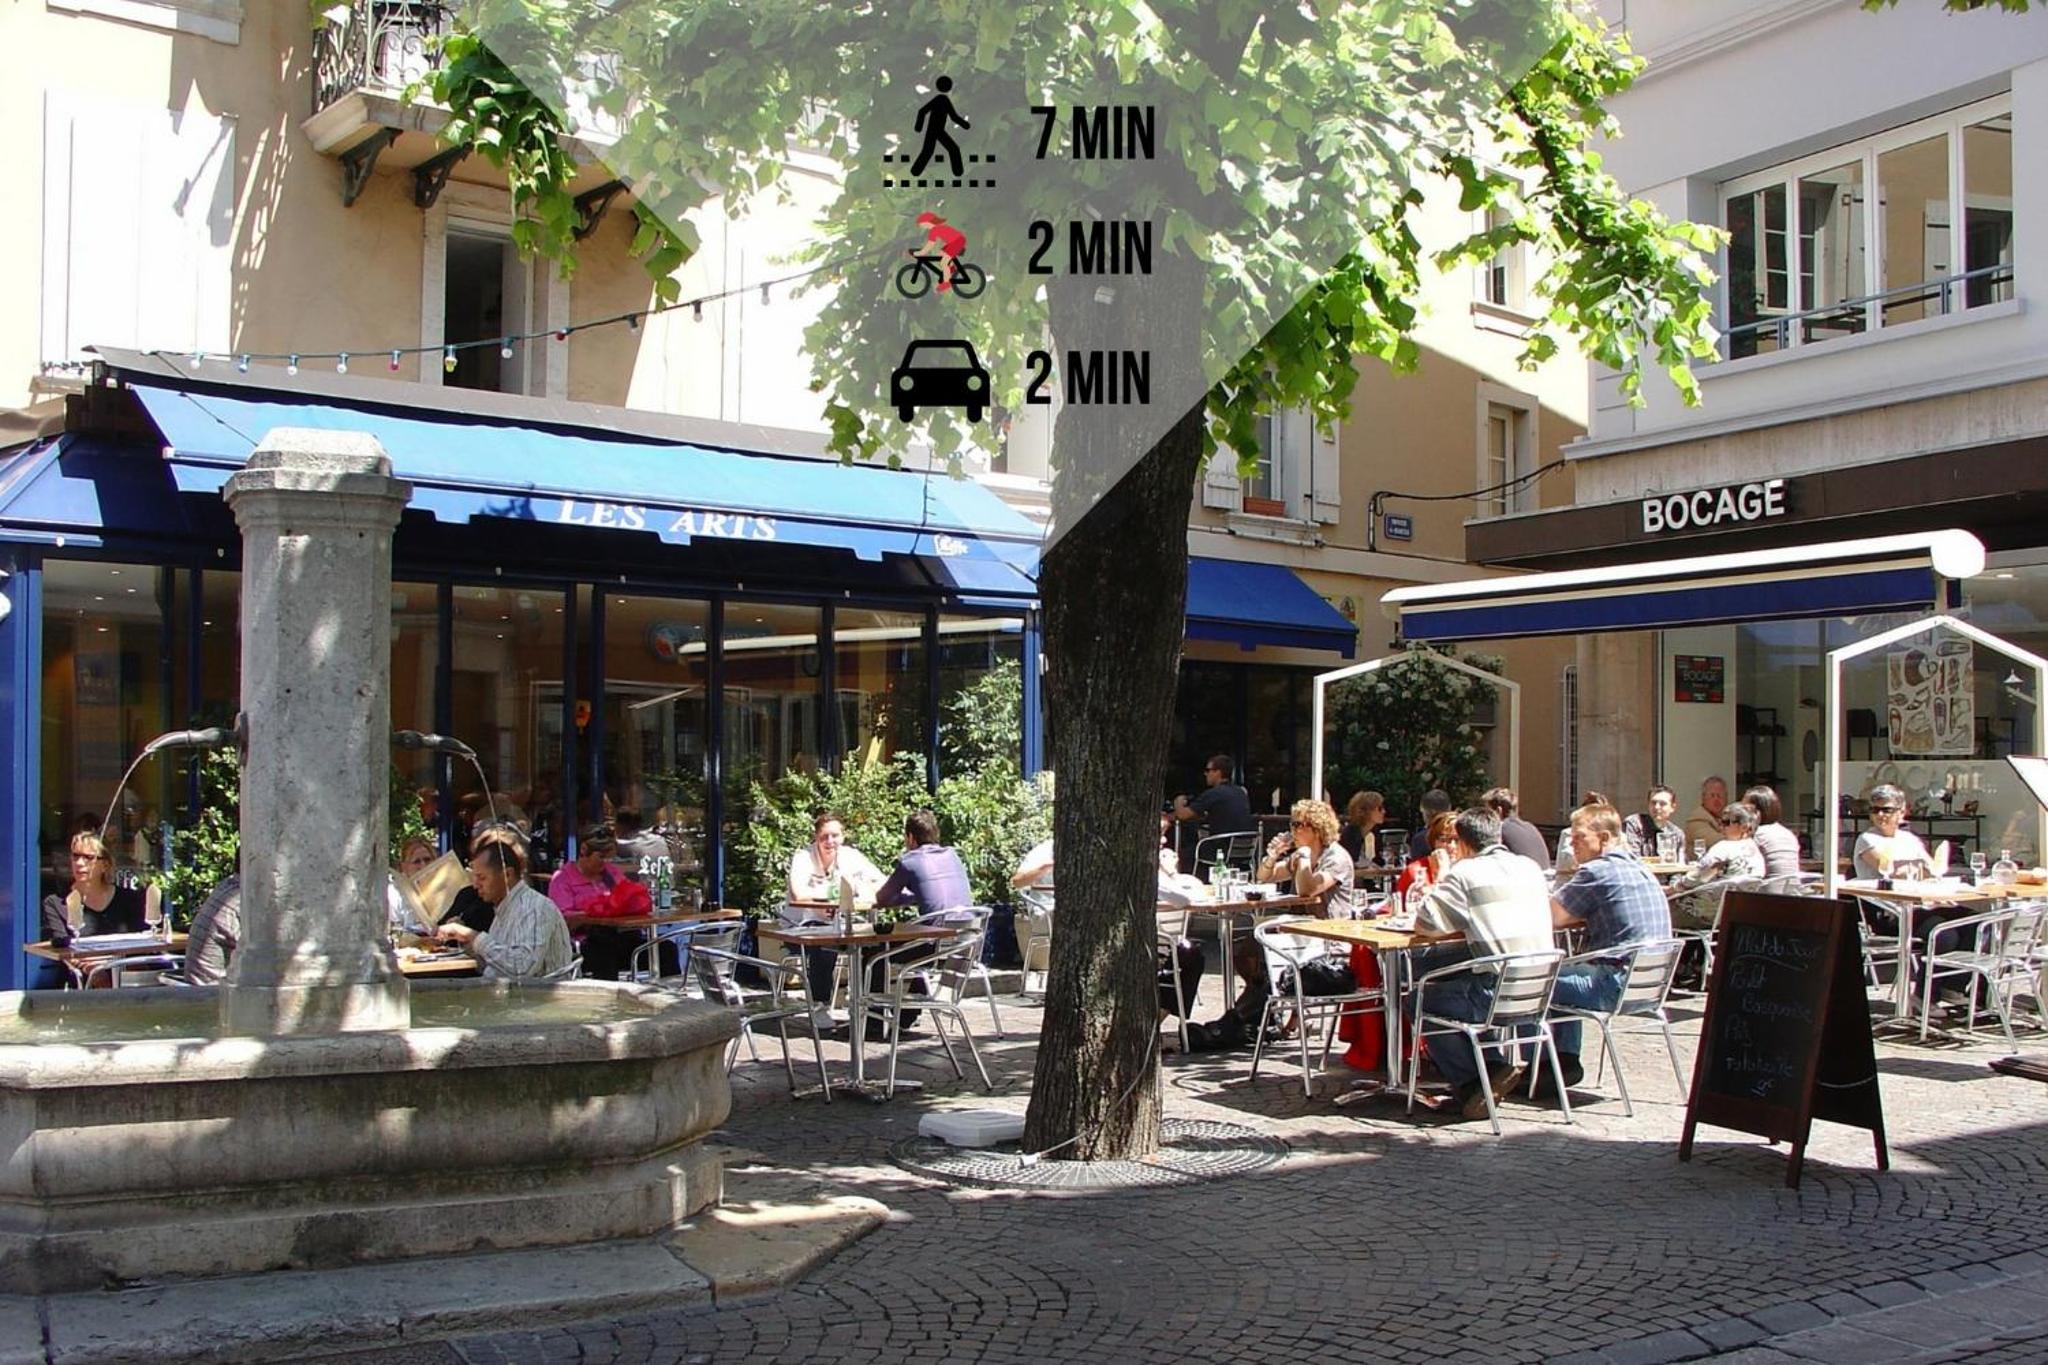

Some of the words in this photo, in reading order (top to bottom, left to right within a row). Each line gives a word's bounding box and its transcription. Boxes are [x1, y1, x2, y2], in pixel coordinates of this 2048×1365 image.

[558, 500, 647, 530] LES
[669, 510, 777, 541] ARTS
[1643, 479, 1786, 533] BOCAGE
